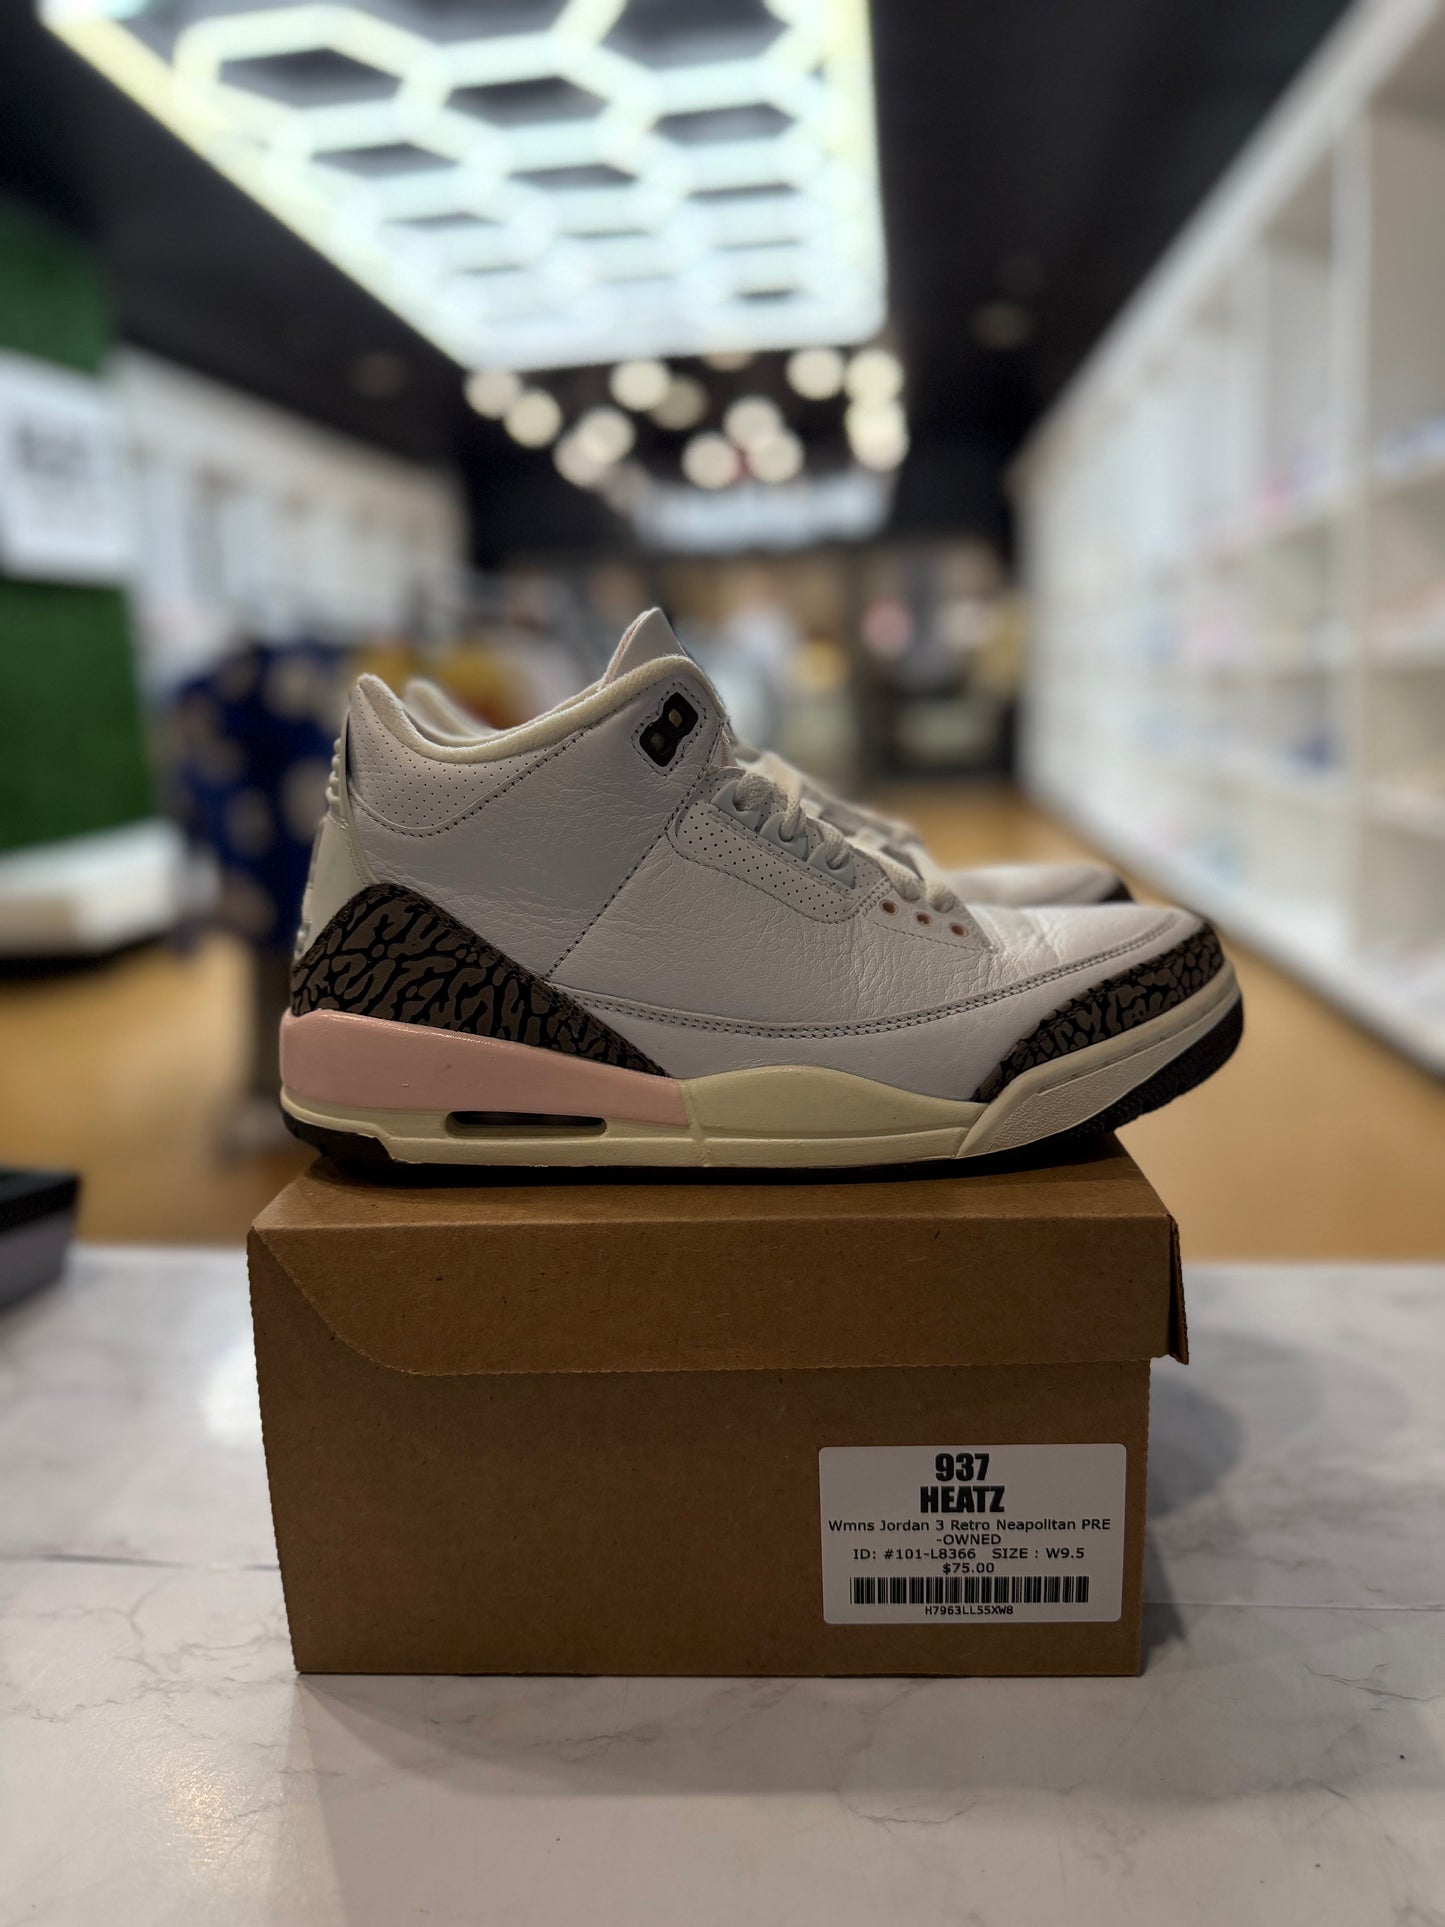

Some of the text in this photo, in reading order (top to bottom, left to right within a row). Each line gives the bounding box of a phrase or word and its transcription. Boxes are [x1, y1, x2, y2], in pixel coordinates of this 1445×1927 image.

[935, 1453, 990, 1481] 937
[920, 1485, 1005, 1513] HEATZ
[828, 1519, 1111, 1533] Wmns Jordan 3 Retro Neapolitan PRE
[936, 1534, 1002, 1545] -OWNED
[853, 1549, 877, 1560] ID:
[884, 1549, 976, 1560] #101-L8366
[992, 1548, 1028, 1559] SIZE
[1045, 1548, 1085, 1559] W9.5
[942, 1562, 995, 1575] $75.00
